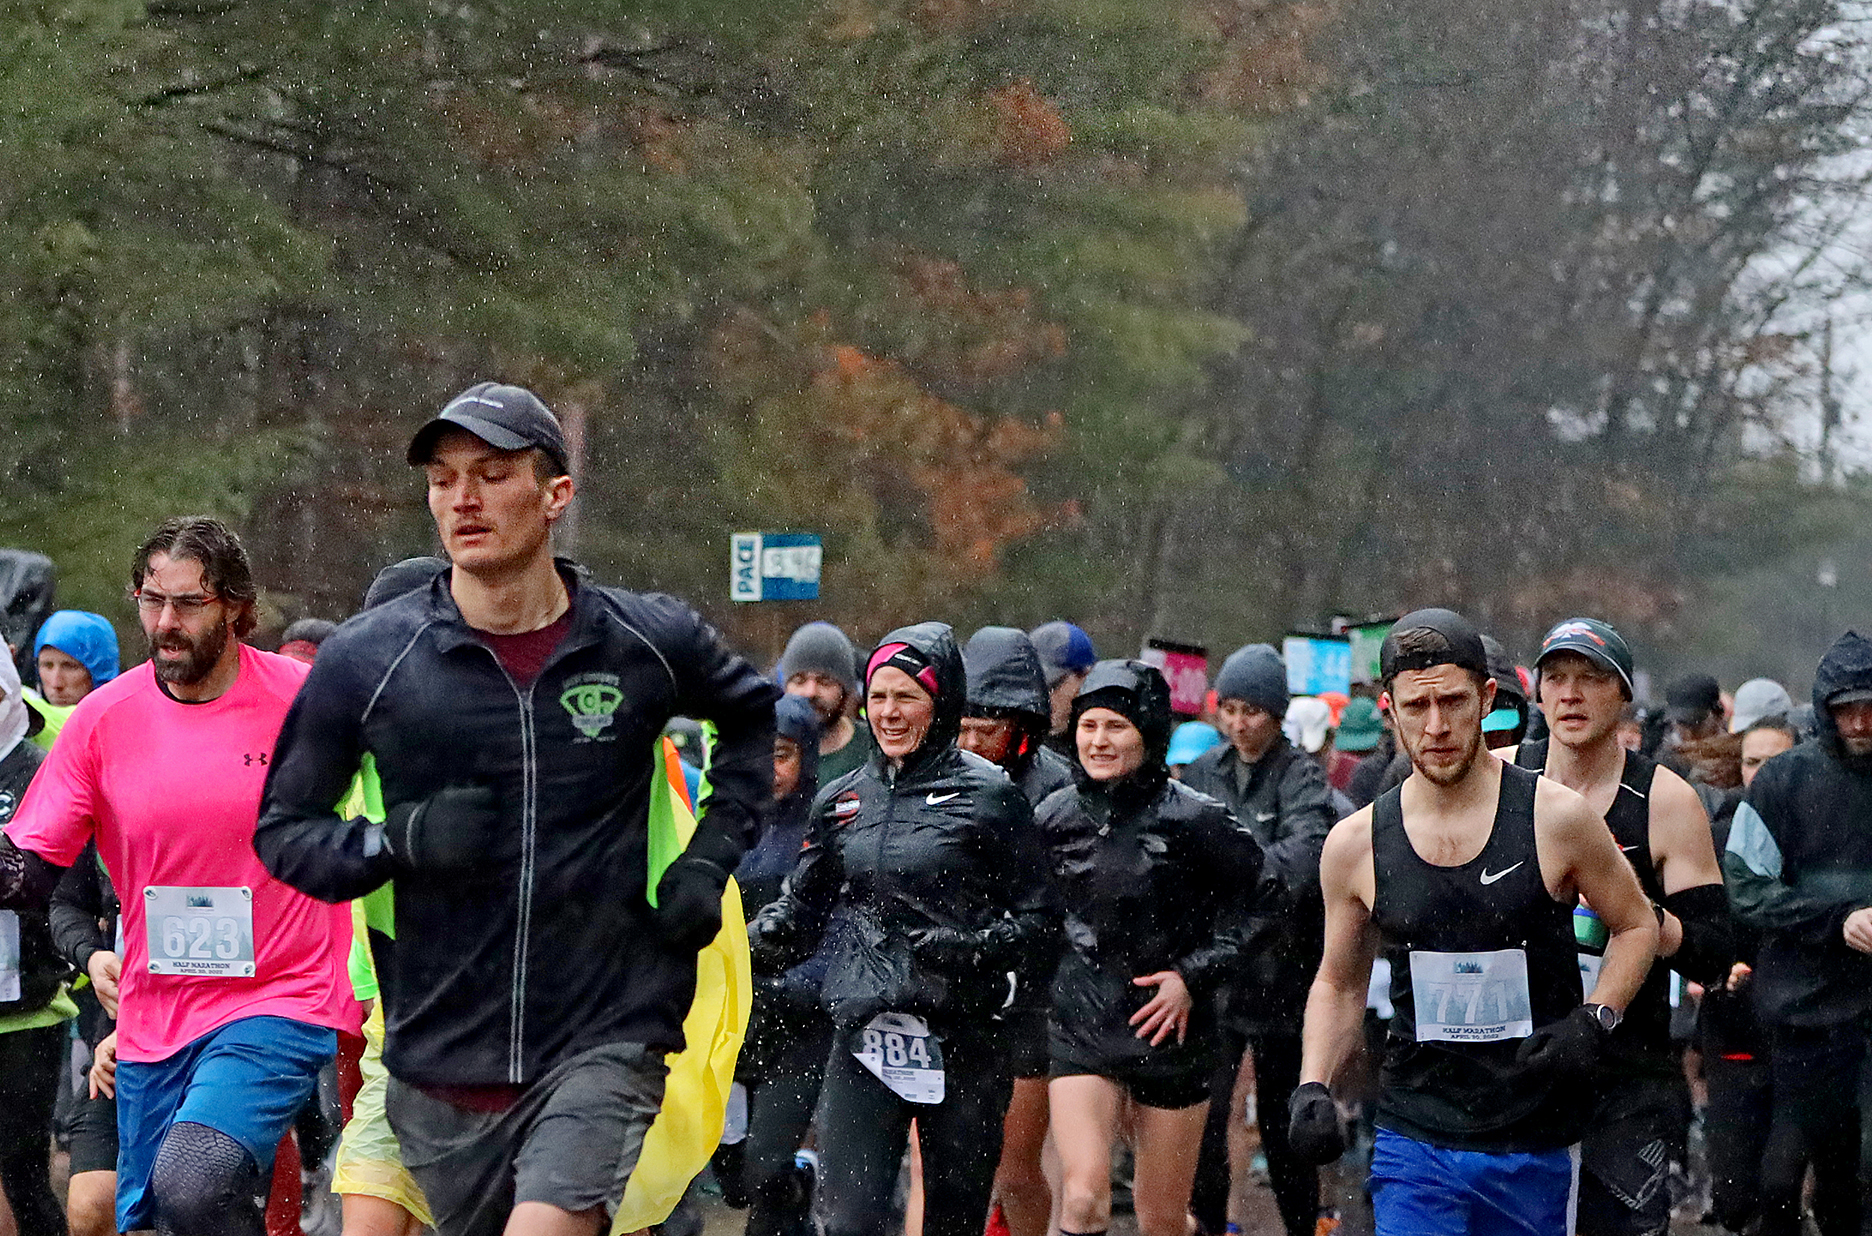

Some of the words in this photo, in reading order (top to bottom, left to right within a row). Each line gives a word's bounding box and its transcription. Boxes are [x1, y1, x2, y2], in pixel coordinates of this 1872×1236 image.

[738, 541, 754, 593] PACE
[162, 916, 240, 959] 623
[191, 962, 231, 970] MARATHON
[1430, 982, 1509, 1024] 771
[863, 1030, 932, 1068] 884
[1463, 1025, 1506, 1034] MARATHON
